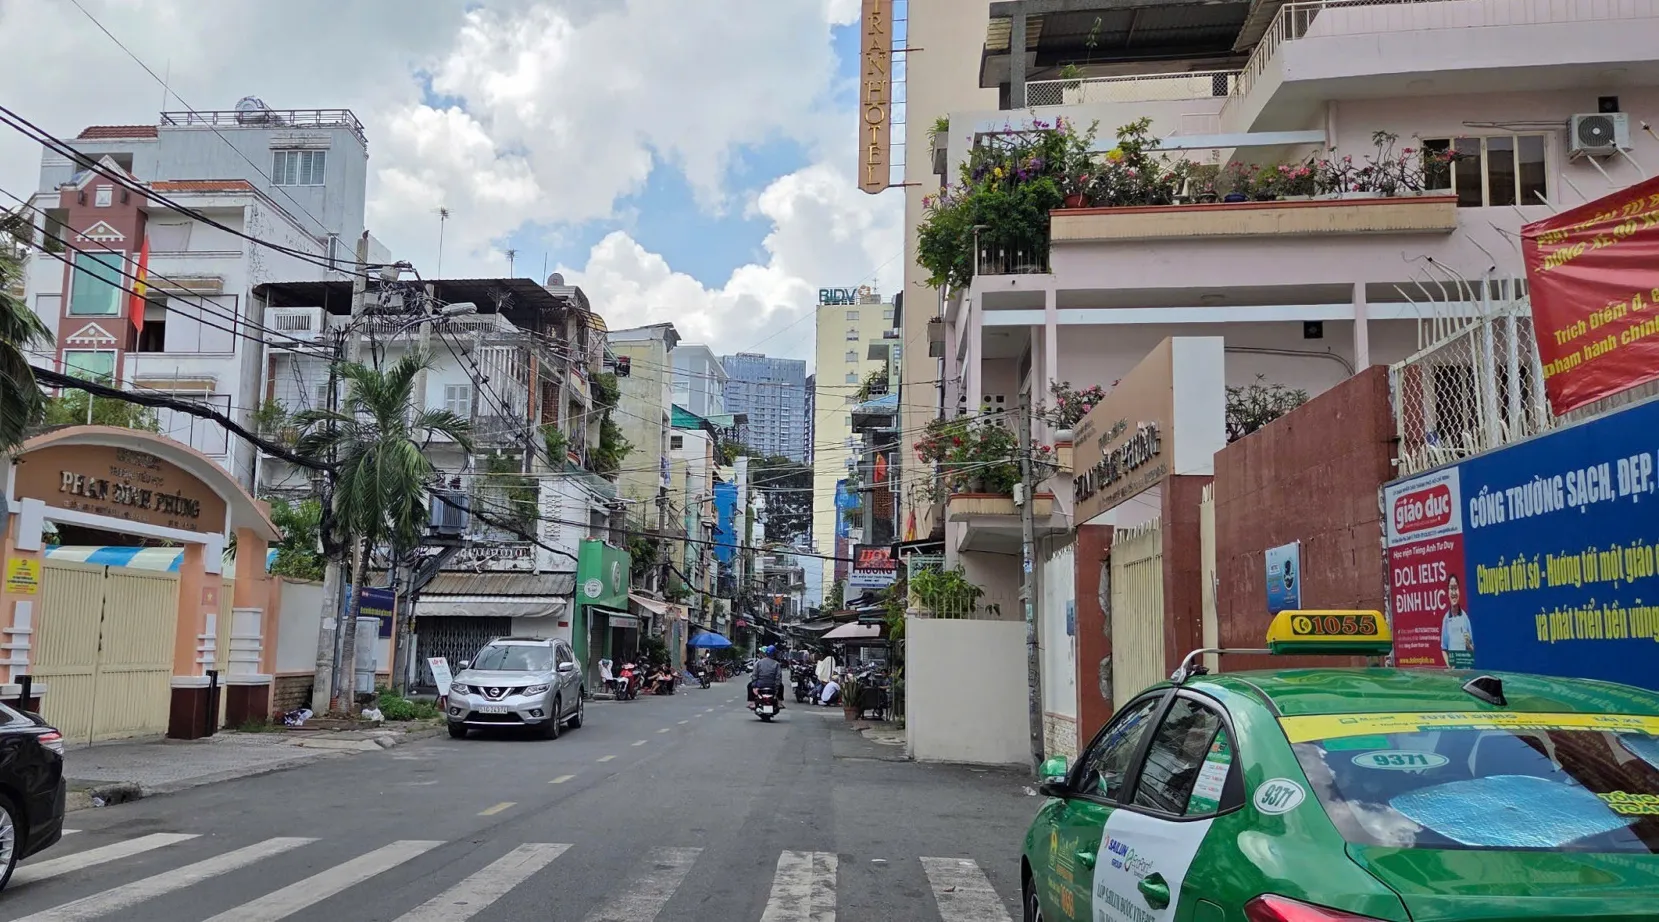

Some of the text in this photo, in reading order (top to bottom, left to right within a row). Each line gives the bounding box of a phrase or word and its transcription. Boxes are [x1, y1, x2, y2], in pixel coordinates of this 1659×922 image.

[864, 80, 887, 186] HOTEL
[819, 288, 857, 303] BIDV
[1583, 334, 1618, 361] hành
[59, 470, 110, 501] PHAN
[1469, 484, 1505, 529] CỔNG
[1506, 475, 1564, 521] TRƯỜNG
[1566, 462, 1615, 514] SẠCH,
[1617, 452, 1655, 504] ĐẸP,
[1396, 493, 1450, 530] giáo dục
[1394, 560, 1447, 587] DOL IELTS
[1476, 554, 1511, 596] Chuyển
[1527, 553, 1540, 589] số
[1545, 550, 1581, 588] Hướng
[1581, 546, 1599, 583] tới
[1599, 543, 1624, 590] một
[1624, 538, 1654, 583] giáo
[1396, 588, 1447, 616] ĐÌNH LỰC
[1312, 615, 1377, 635] 1055
[1535, 607, 1549, 641] và
[1549, 604, 1575, 644] phát
[1574, 598, 1603, 640] triển
[1603, 600, 1628, 640] bền
[1373, 754, 1429, 766] 9371
[1262, 784, 1296, 808] 9371
[1108, 838, 1129, 857] SAILUN
